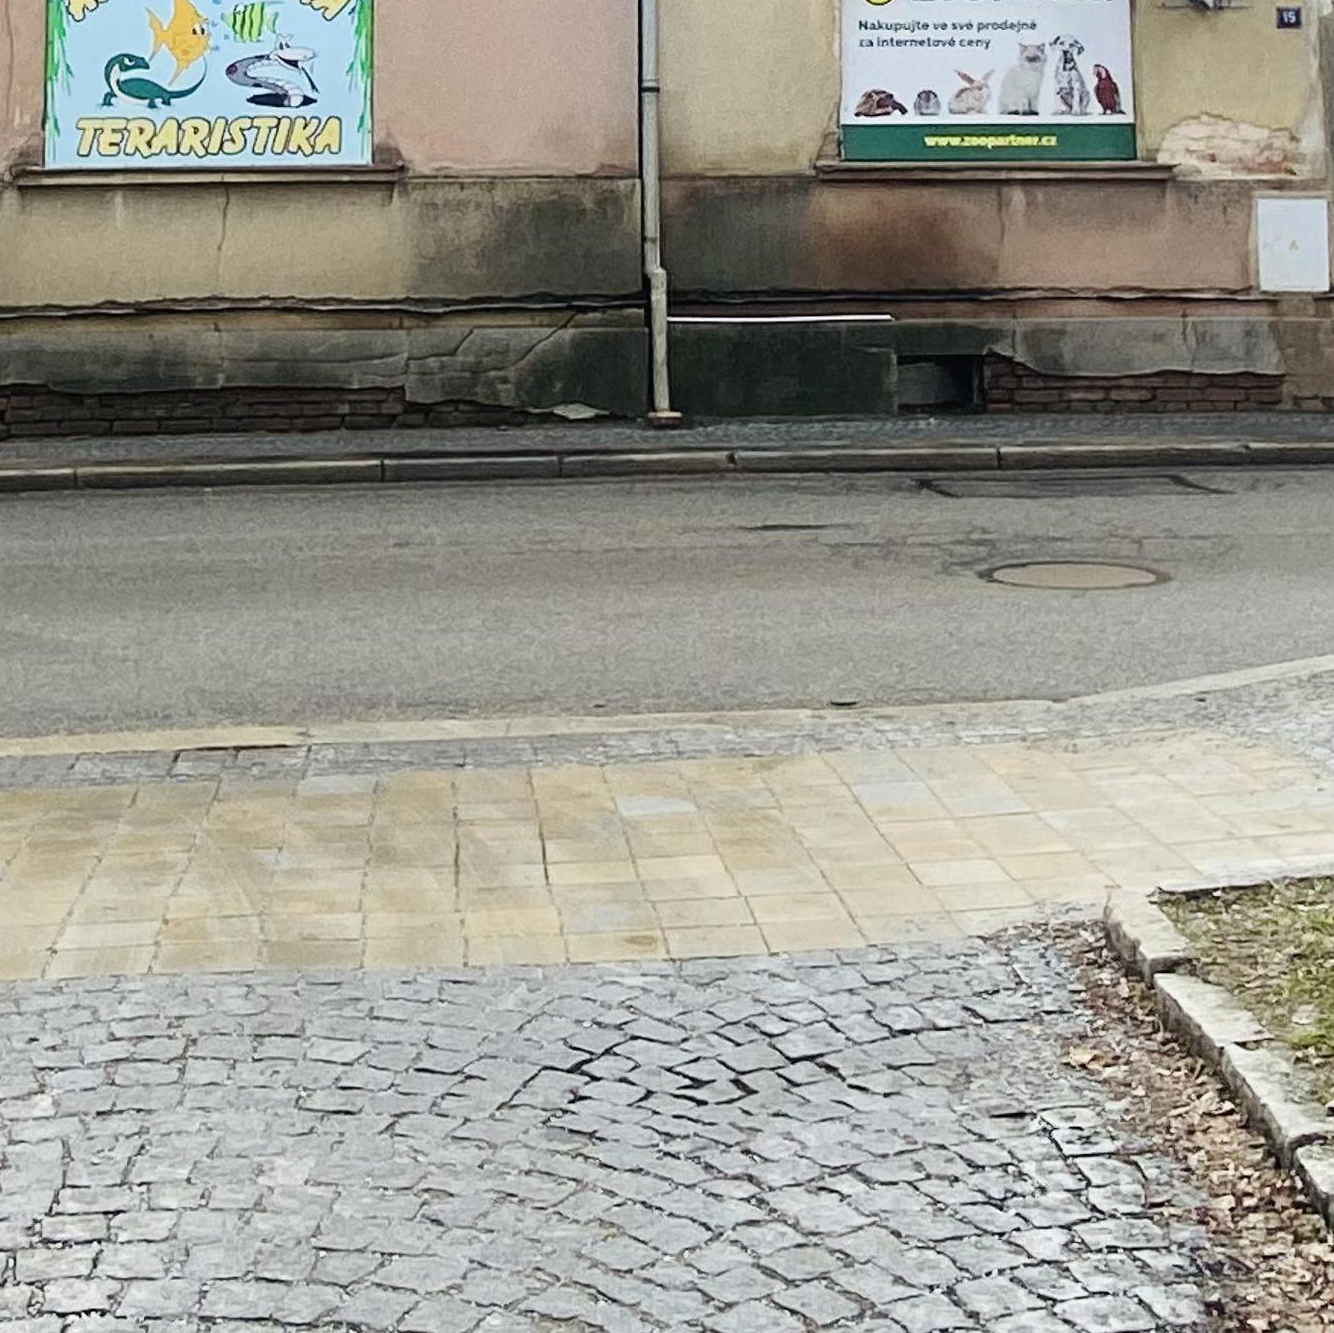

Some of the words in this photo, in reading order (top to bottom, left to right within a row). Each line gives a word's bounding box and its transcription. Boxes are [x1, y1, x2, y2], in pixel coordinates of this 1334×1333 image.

[1282, 11, 1297, 23] 15
[858, 19, 930, 33] Nakupujte
[933, 22, 948, 31] ve
[858, 39, 874, 47] za
[959, 39, 991, 50] ceny
[76, 117, 342, 157] TERARISTIKA
[924, 135, 1058, 149] www.zoopartner.cz
